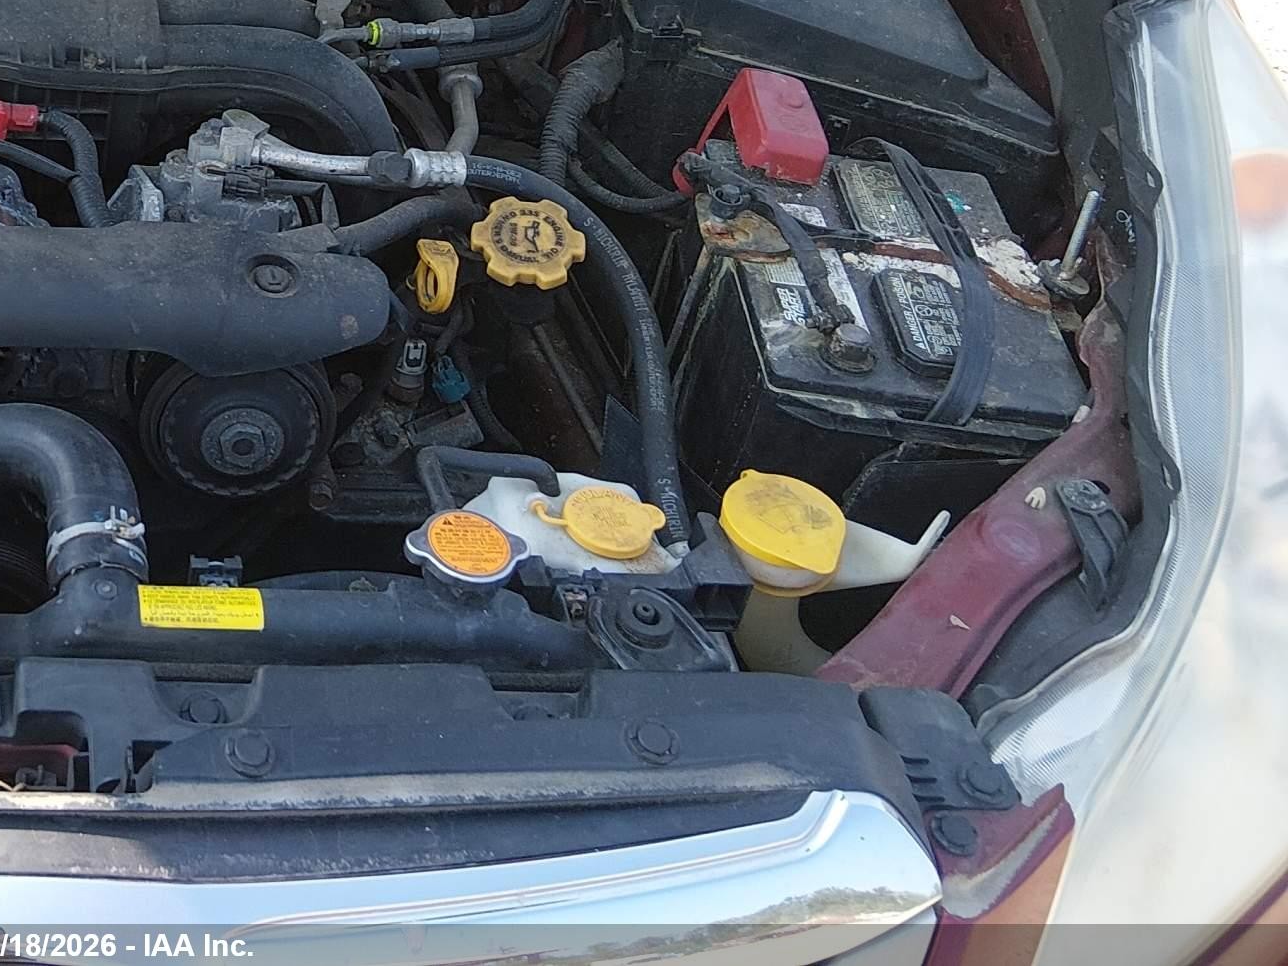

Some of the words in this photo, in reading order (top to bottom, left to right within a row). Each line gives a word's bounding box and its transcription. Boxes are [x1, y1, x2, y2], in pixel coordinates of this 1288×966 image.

[543, 216, 564, 247] ENGINE
[776, 287, 794, 321] SUPER
[889, 276, 910, 304] POISON
[787, 287, 806, 326] START
[903, 310, 922, 341] DANGER
